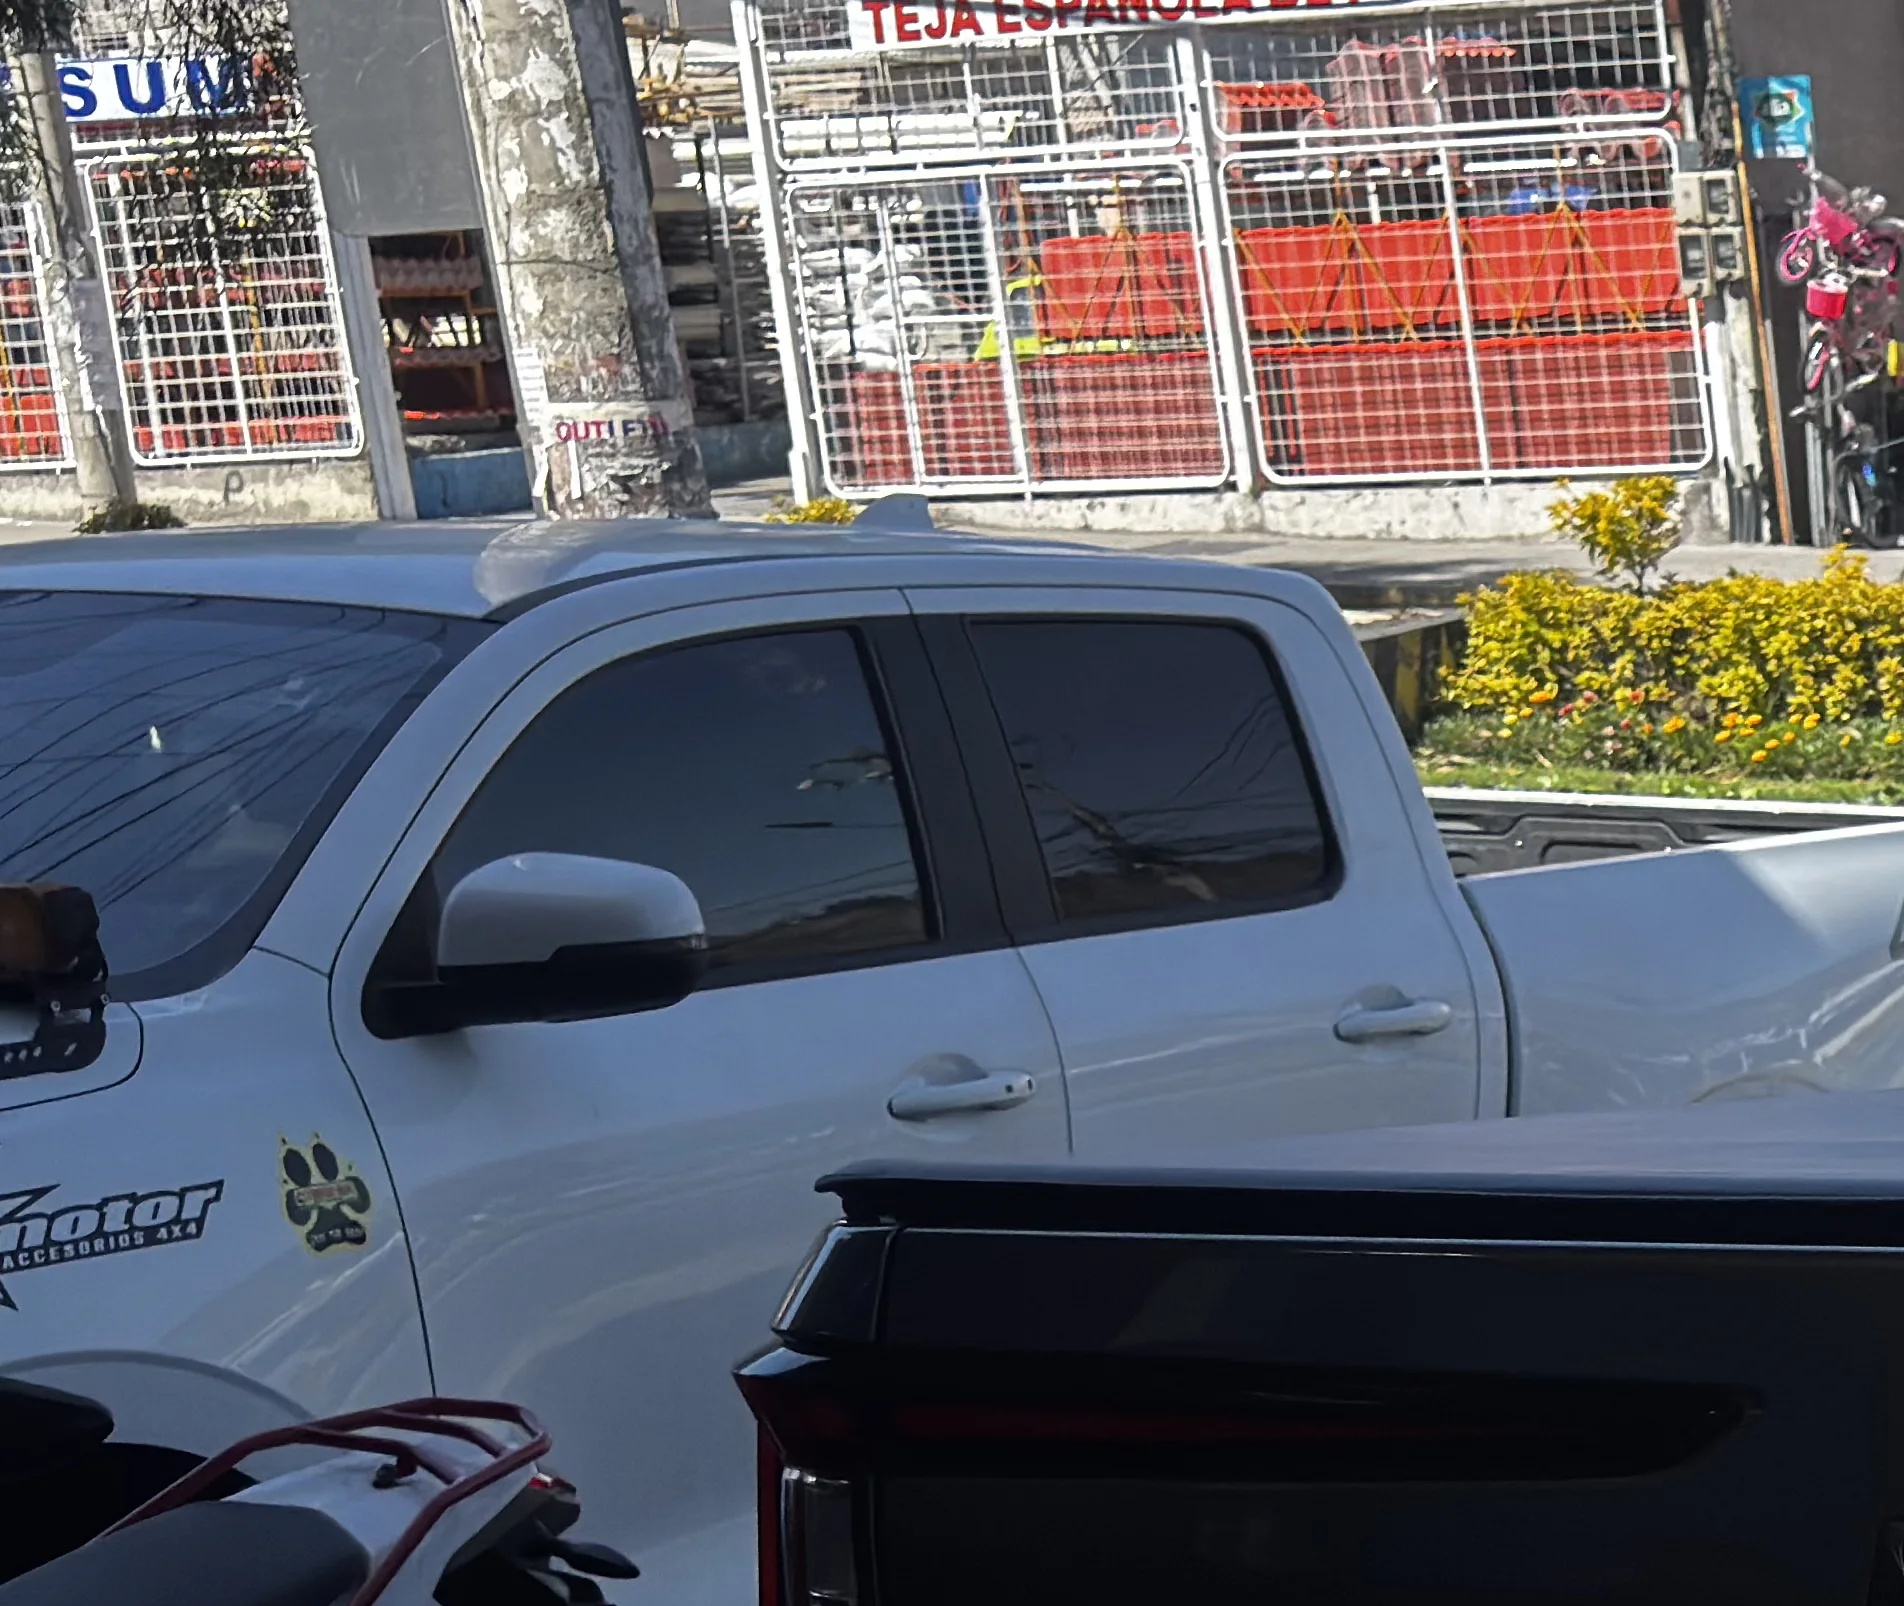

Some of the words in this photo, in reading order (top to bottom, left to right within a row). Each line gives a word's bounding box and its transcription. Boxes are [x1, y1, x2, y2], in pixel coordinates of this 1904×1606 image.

[862, 1, 984, 44] TEJA
[2, 1231, 145, 1270] ACCESORIOS
[156, 1221, 198, 1240] 4X4
